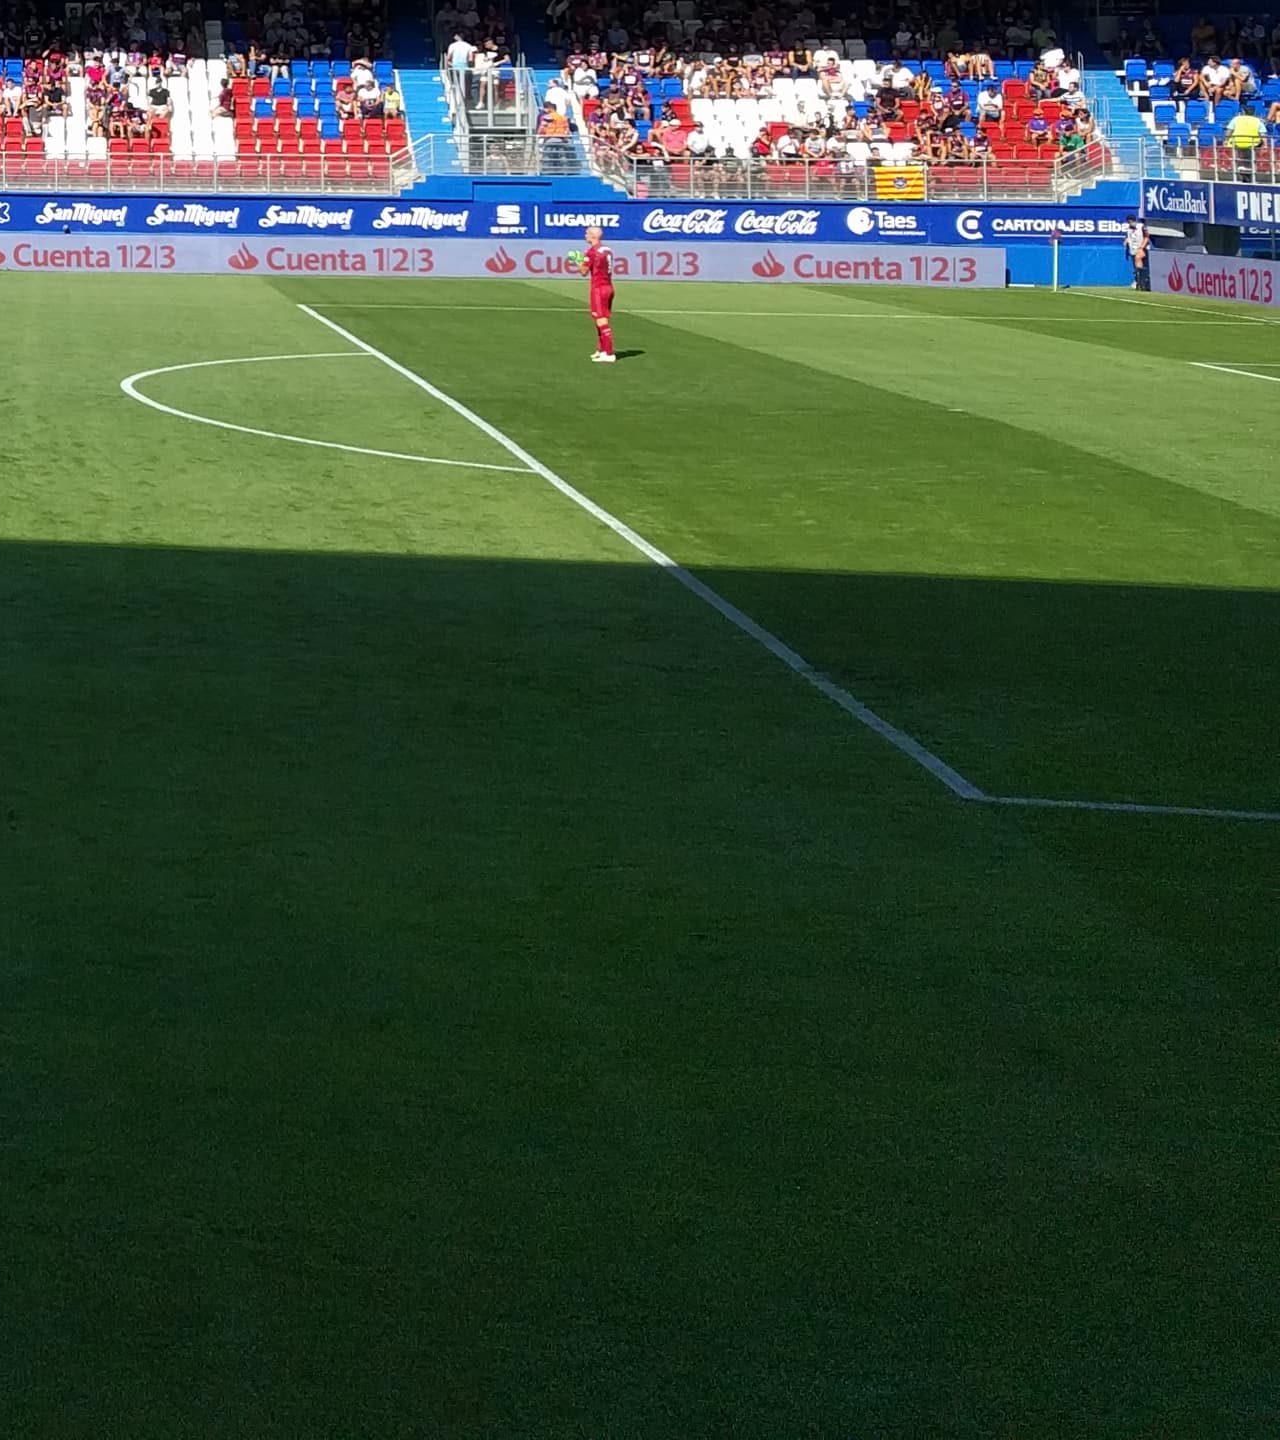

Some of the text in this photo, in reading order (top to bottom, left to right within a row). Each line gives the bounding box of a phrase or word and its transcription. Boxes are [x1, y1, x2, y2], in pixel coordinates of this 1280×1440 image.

[1160, 187, 1207, 215] CaixaBank
[544, 213, 619, 228] LUGARITZ
[874, 211, 917, 229] Taes
[992, 217, 1094, 232] CARTONAJES
[13, 243, 110, 268] Cuenta
[266, 247, 366, 272] Cuenta
[793, 254, 902, 281] Cuenta
[1186, 262, 1237, 300] Cuenta
